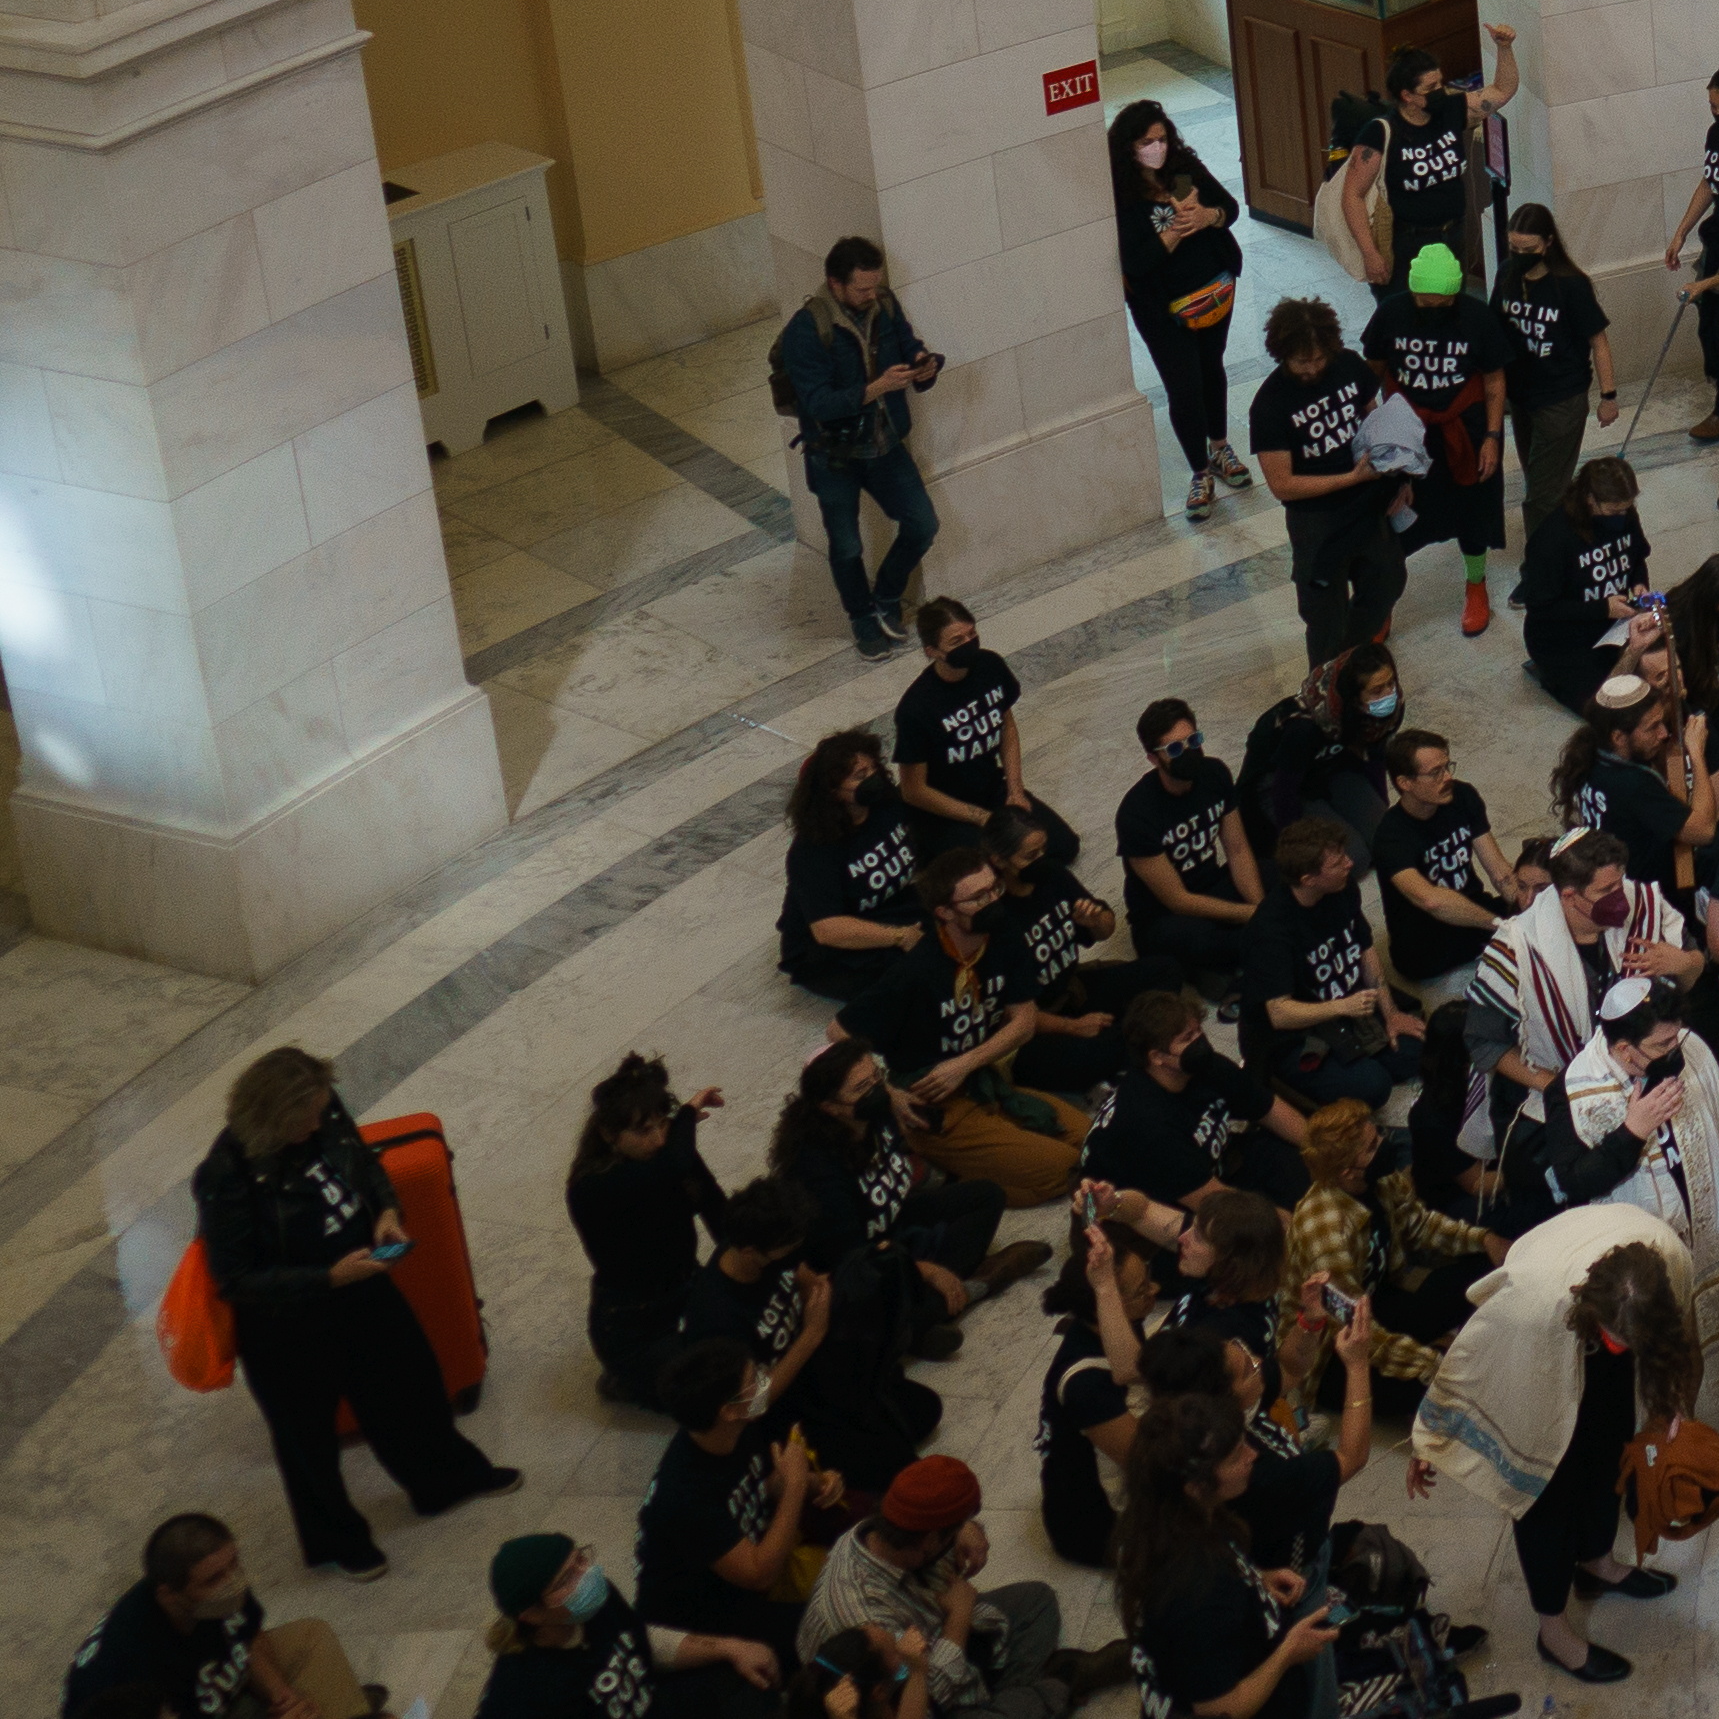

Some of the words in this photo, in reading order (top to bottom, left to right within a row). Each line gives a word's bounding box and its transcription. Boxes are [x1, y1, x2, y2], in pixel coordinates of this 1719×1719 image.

[1048, 73, 1094, 103] EXIT
[1402, 143, 1434, 161] NOT
[1435, 131, 1456, 150] IN
[1413, 149, 1460, 177] OUR
[1538, 307, 1559, 322] IN
[1395, 337, 1434, 352] NOT
[1440, 341, 1468, 355] IN
[1405, 355, 1458, 373] OUR
[1292, 395, 1332, 427] NOT
[1337, 383, 1359, 403] IN
[1310, 404, 1356, 439] OUR
[1579, 544, 1614, 568] NOT
[1616, 535, 1632, 554] IN
[1592, 555, 1631, 581] OUR
[942, 703, 979, 732] NOT
[956, 713, 1004, 742] OUR
[1162, 816, 1201, 848] NOT
[848, 846, 888, 879] NOT
[756, 1290, 786, 1339] NOT
